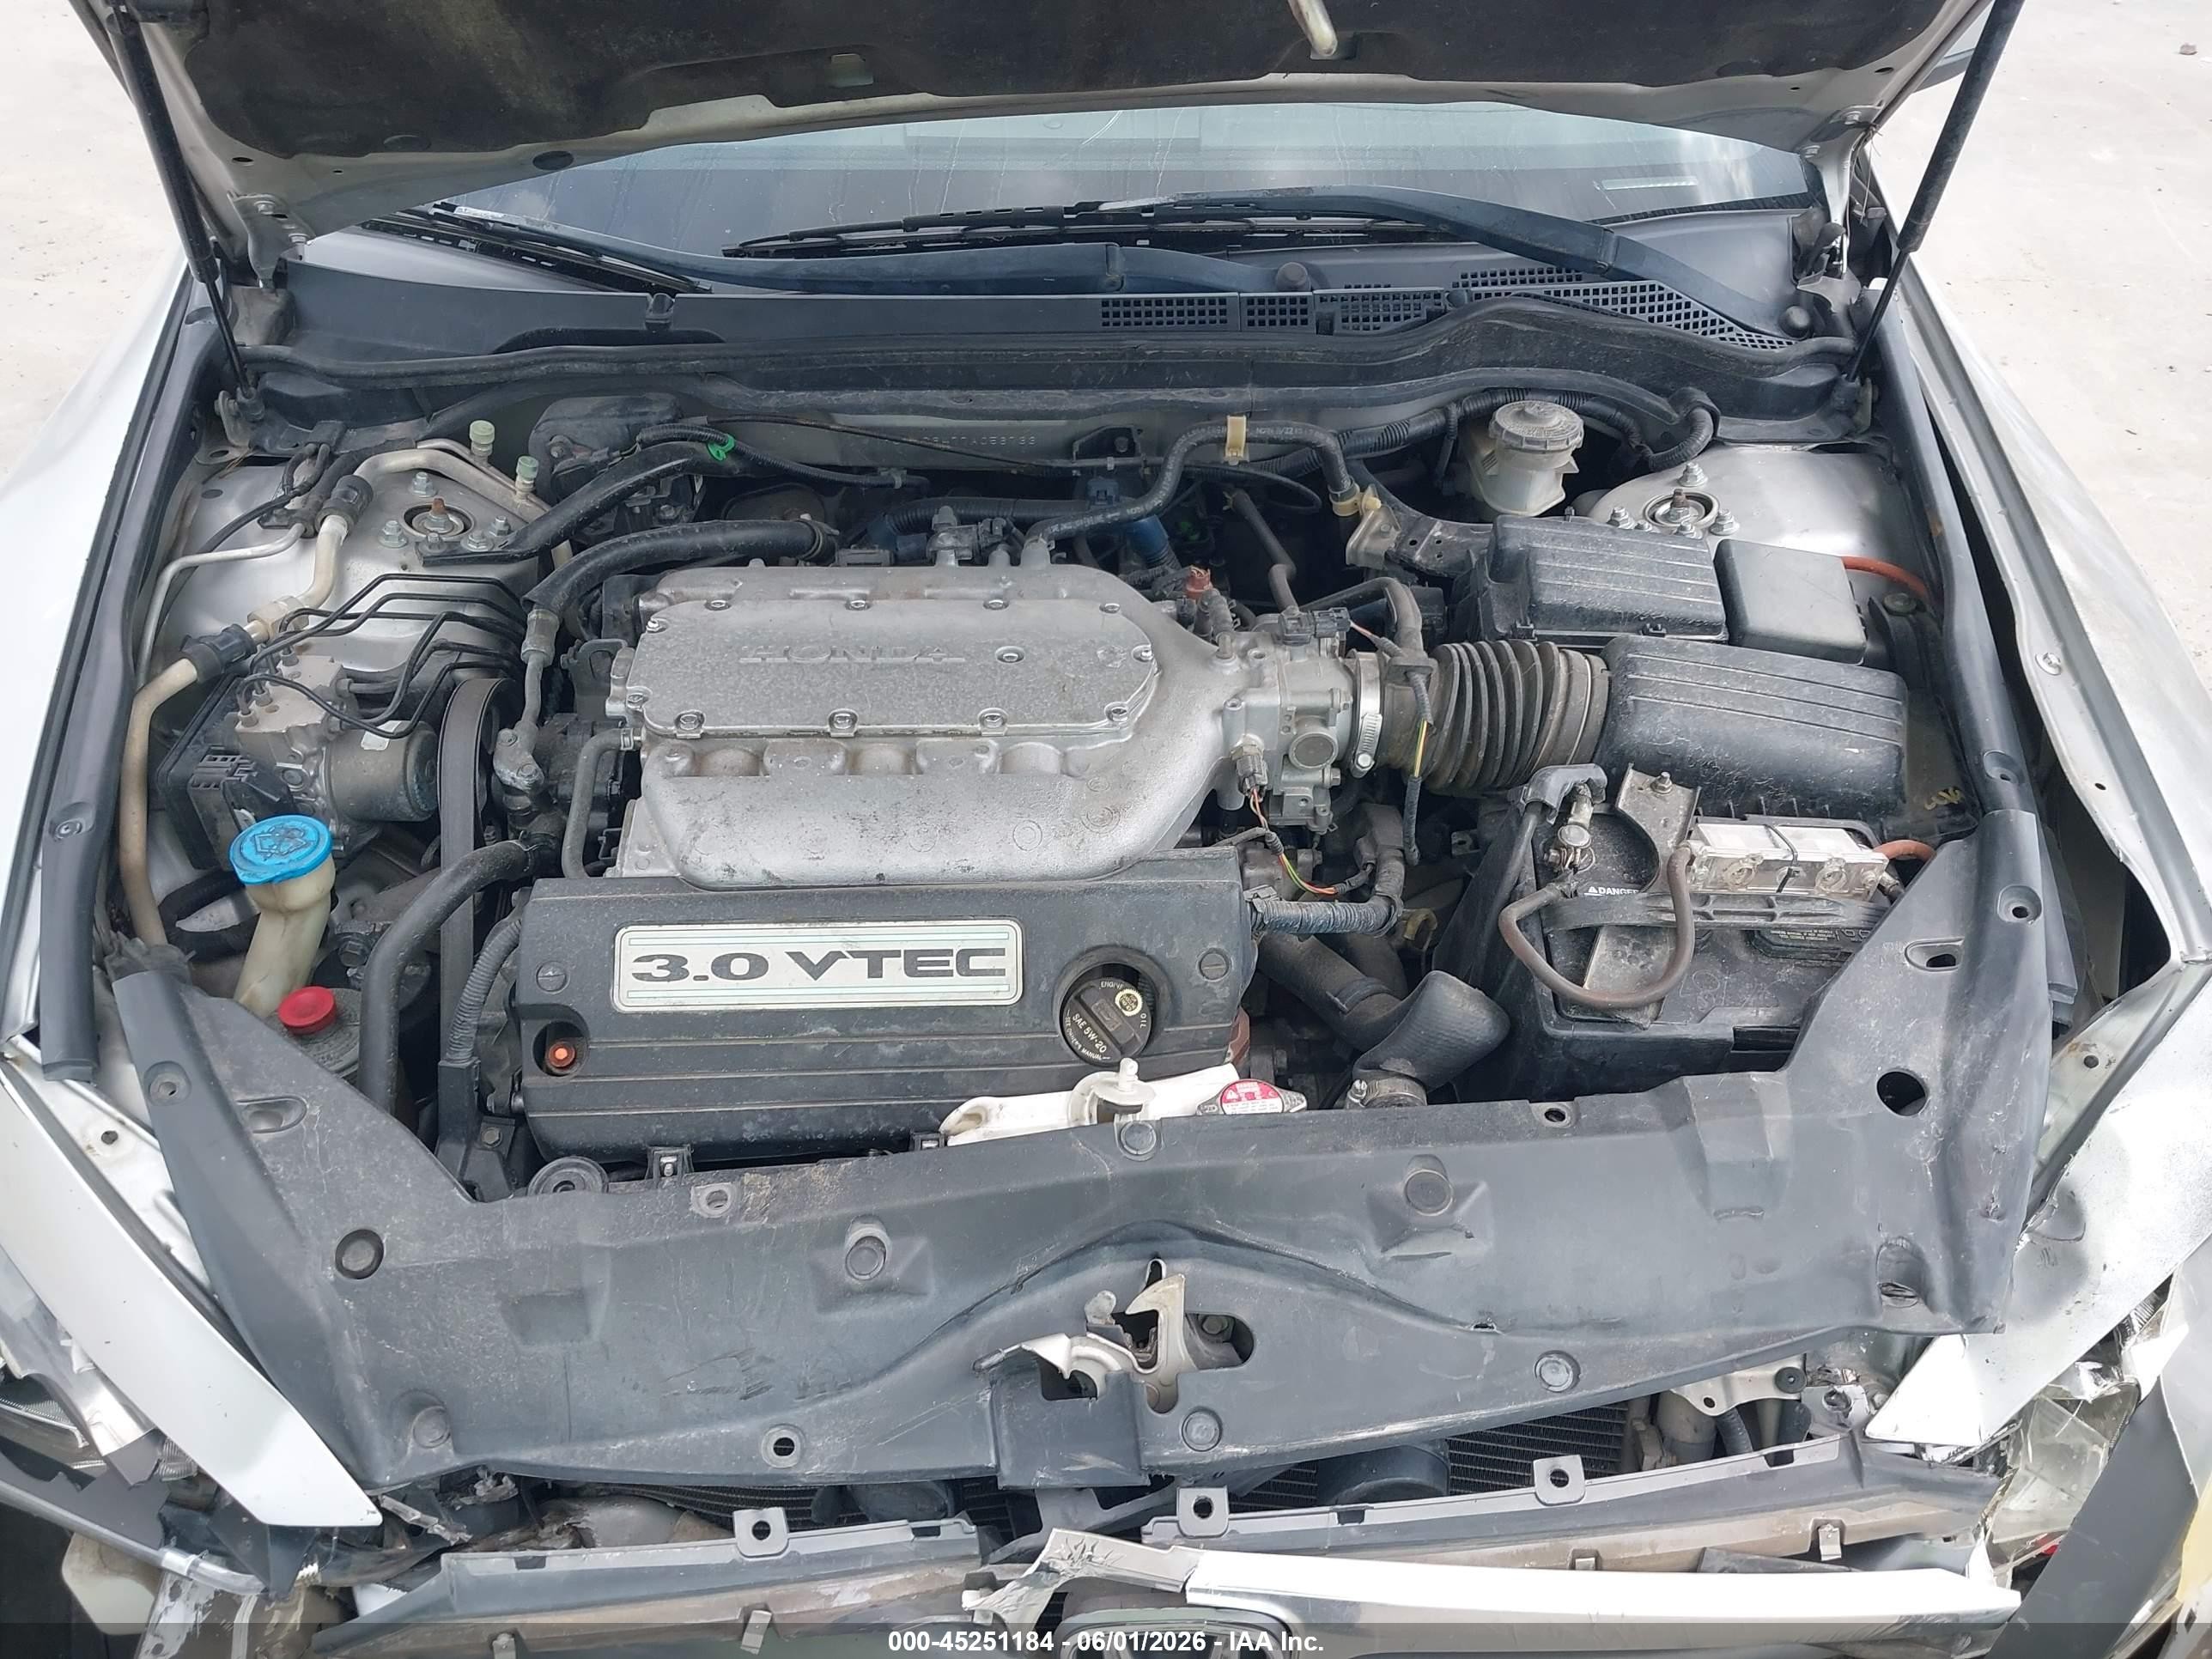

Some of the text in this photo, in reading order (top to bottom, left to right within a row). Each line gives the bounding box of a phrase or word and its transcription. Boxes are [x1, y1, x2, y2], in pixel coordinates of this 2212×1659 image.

[738, 645, 965, 664] HONDA
[631, 947, 1006, 982] 3.0 VTEC
[1072, 1012, 1087, 1030] SAE
[1080, 1047, 1103, 1060] MANUAL
